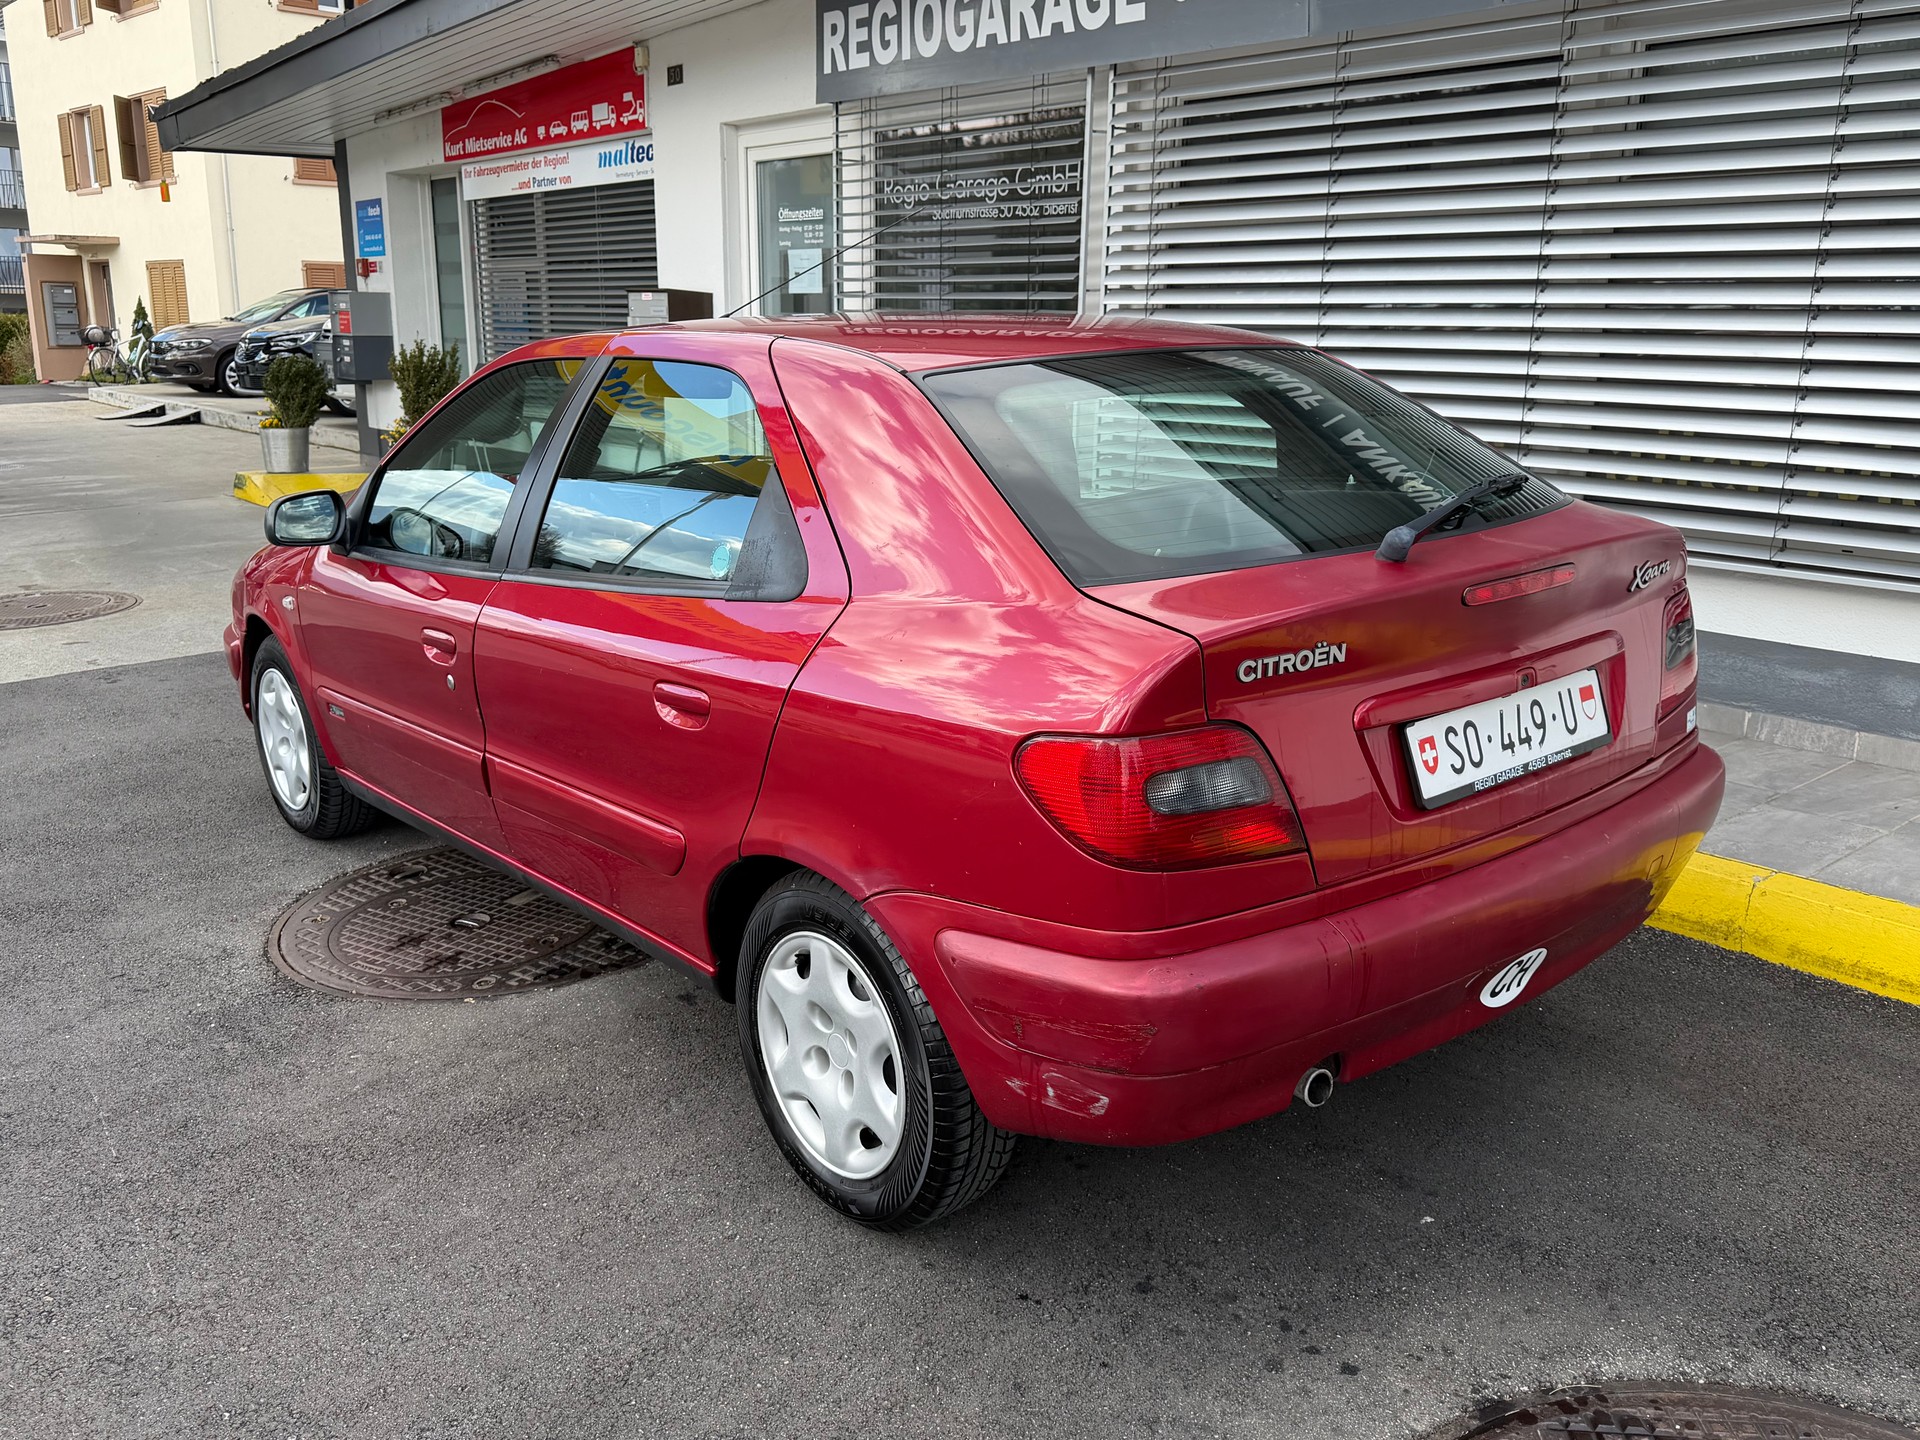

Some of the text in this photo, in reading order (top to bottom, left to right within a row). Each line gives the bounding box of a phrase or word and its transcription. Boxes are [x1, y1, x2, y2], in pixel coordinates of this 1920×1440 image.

[445, 127, 527, 157] Kurt Mietservice AG
[464, 152, 570, 179] Ihr Fahrzeugvermieter der Region!
[532, 175, 557, 188] Partner
[559, 175, 572, 185] von
[1016, 160, 1081, 196] GmbH
[1628, 560, 1671, 592] Xsara
[1238, 641, 1347, 683] CITROËN
[1474, 748, 1572, 791] REGIO GARAGE 4562 Biberist
[1489, 950, 1543, 998] CH
